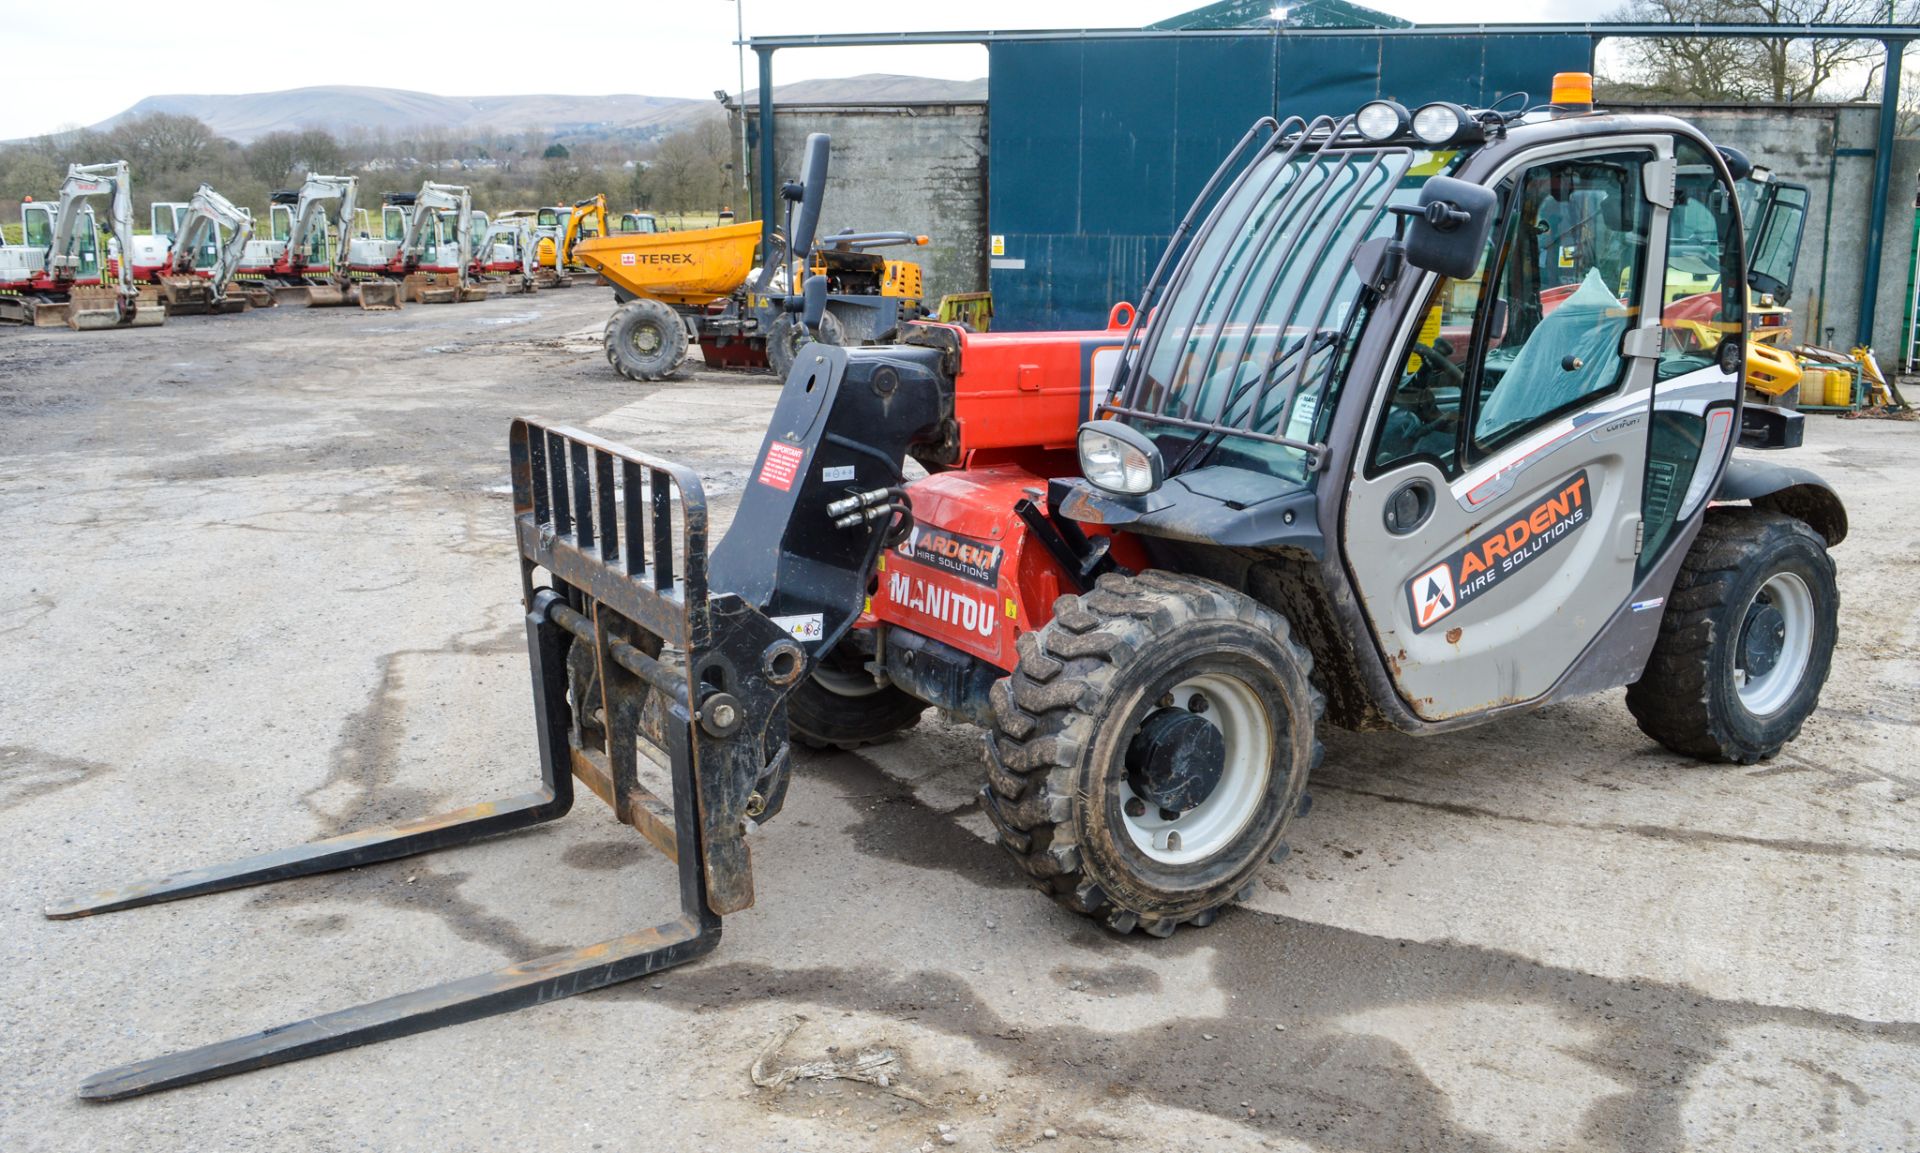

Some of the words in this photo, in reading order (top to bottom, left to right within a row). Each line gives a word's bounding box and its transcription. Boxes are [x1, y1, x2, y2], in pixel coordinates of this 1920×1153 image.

[639, 253, 692, 264] TEREX
[917, 532, 1001, 570] ARDENT
[1459, 476, 1585, 585] ARDENT
[1459, 568, 1496, 599] HIRE
[1502, 508, 1584, 571] SOLUTIONS
[916, 549, 935, 562] HIRE
[938, 557, 989, 581] SOLUTIONS
[889, 570, 995, 637] MANITOU
